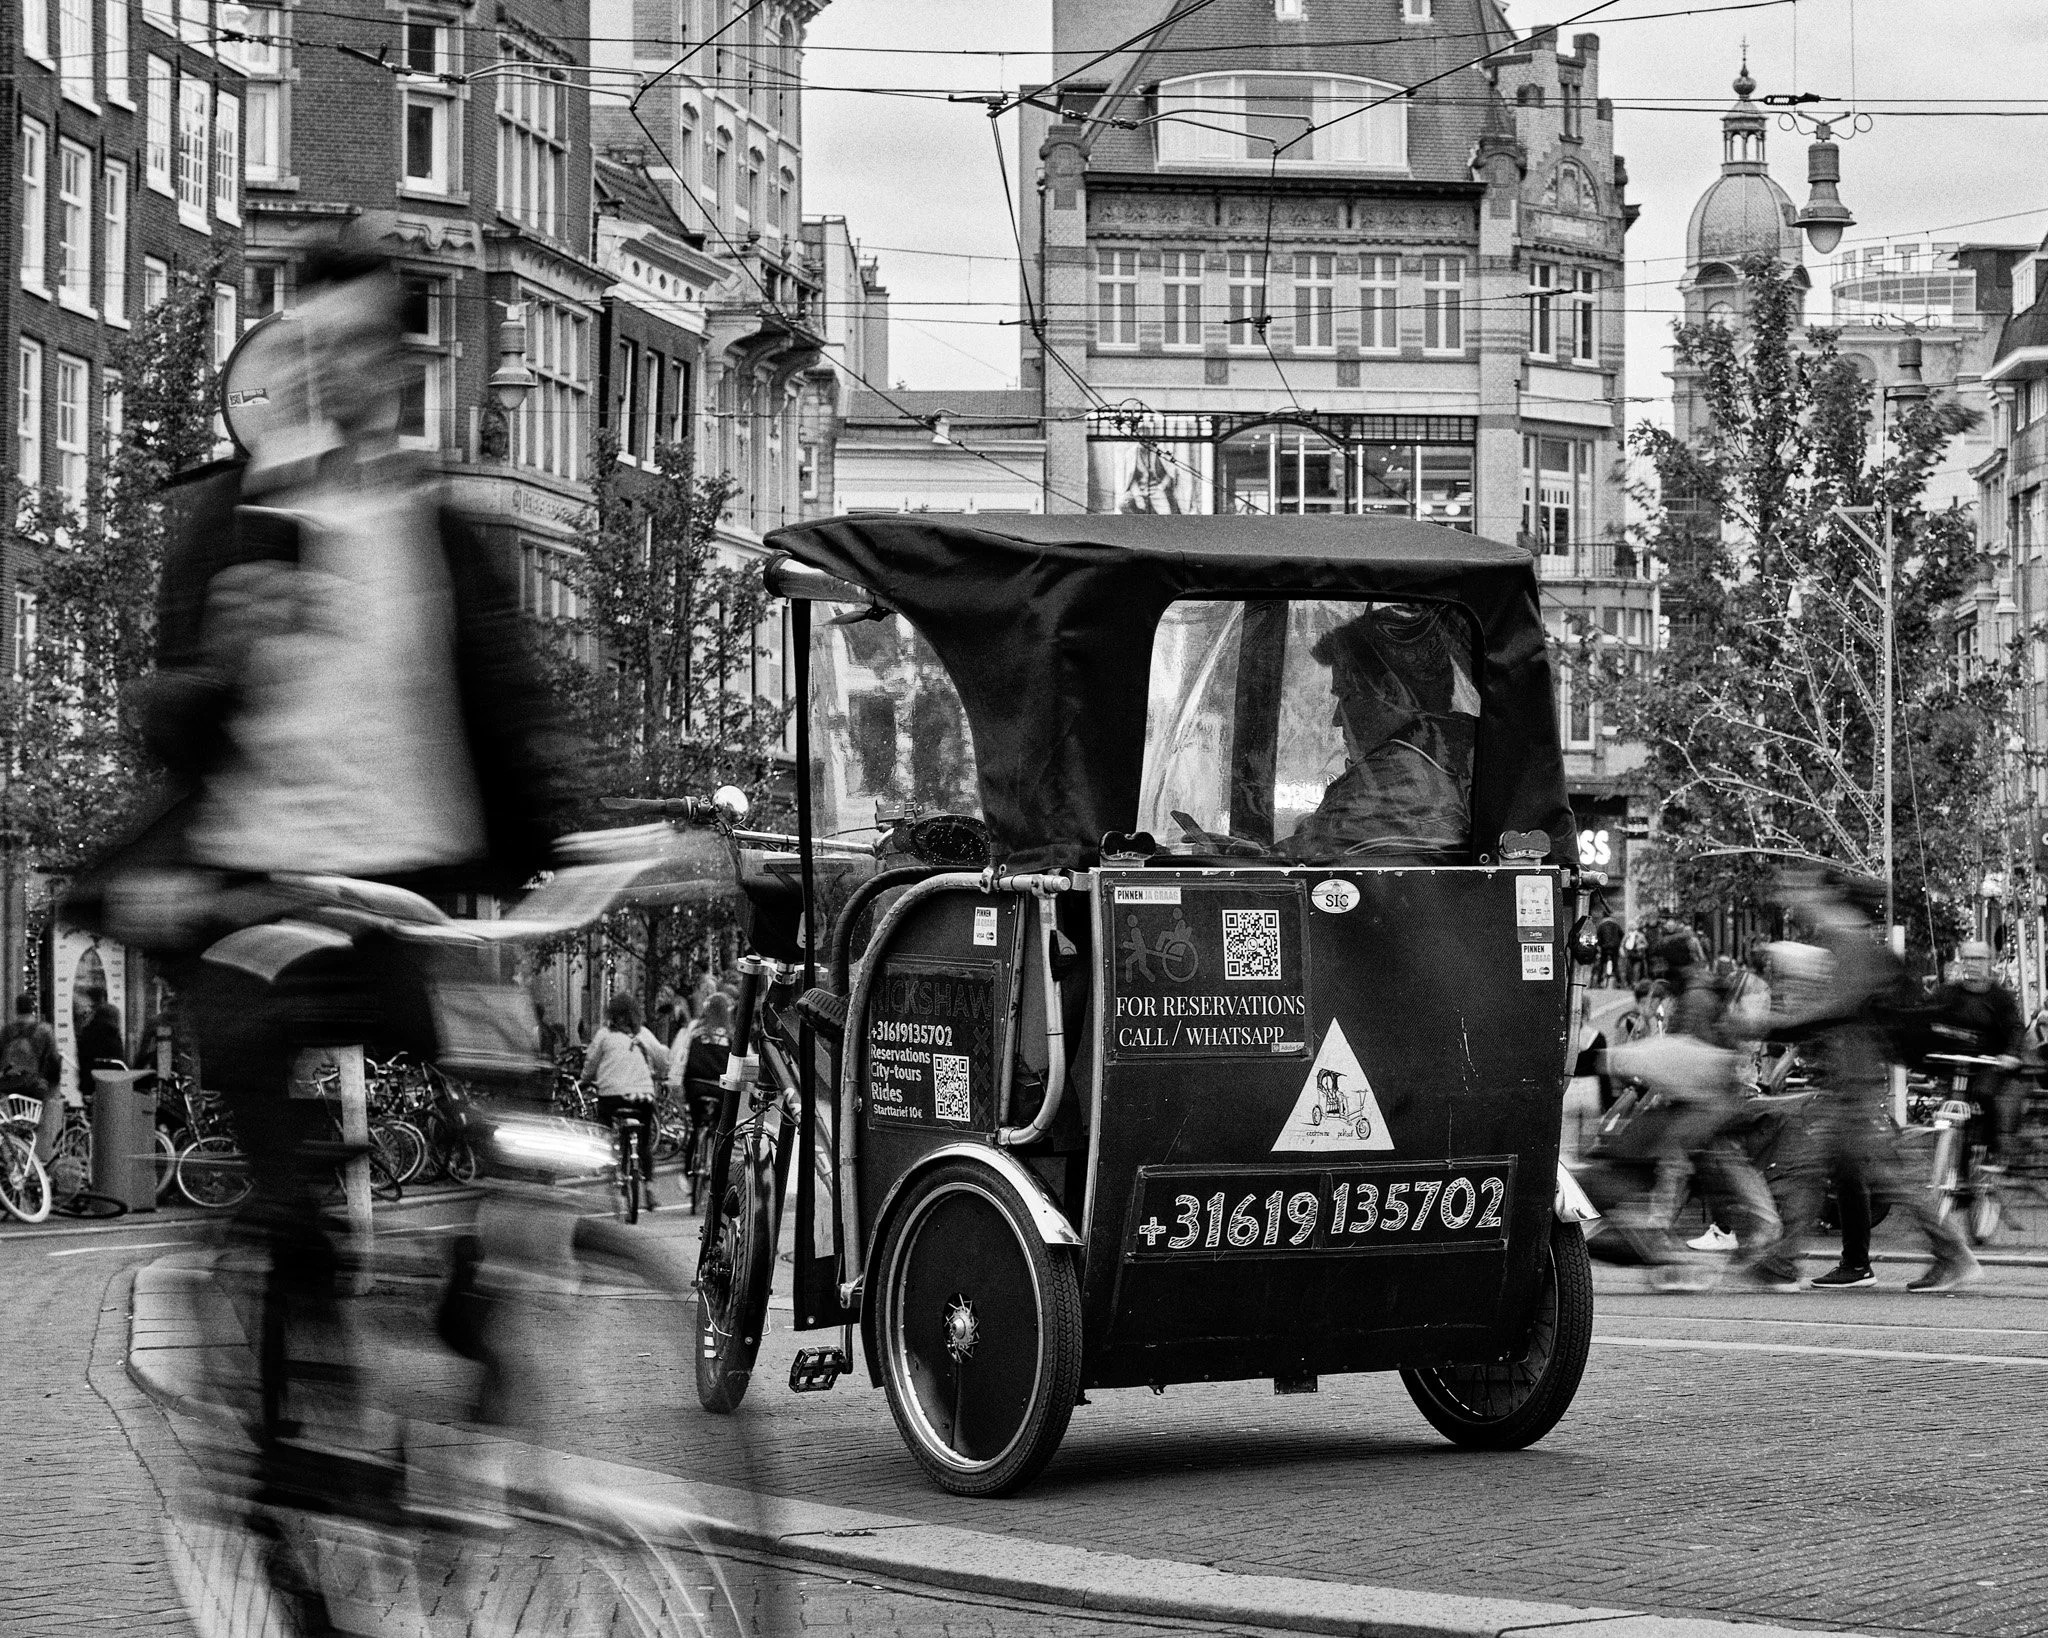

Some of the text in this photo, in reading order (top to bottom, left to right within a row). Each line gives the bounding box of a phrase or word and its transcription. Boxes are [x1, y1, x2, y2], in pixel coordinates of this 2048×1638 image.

[1117, 890, 1144, 900] PINNEN
[1325, 894, 1349, 908] SIC
[1523, 945, 1545, 954] PINNEN
[1115, 995, 1305, 1017] FOR RESERVATIONS
[870, 1020, 953, 1046] +31619135702
[1119, 1019, 1285, 1047] CALL / WHATSAPP
[870, 1043, 931, 1064] Reservations
[870, 1061, 922, 1082] City-tours
[871, 1081, 903, 1103] Rides
[873, 1103, 909, 1118] Starttarief
[1138, 1177, 1504, 1249] +31619 135702
